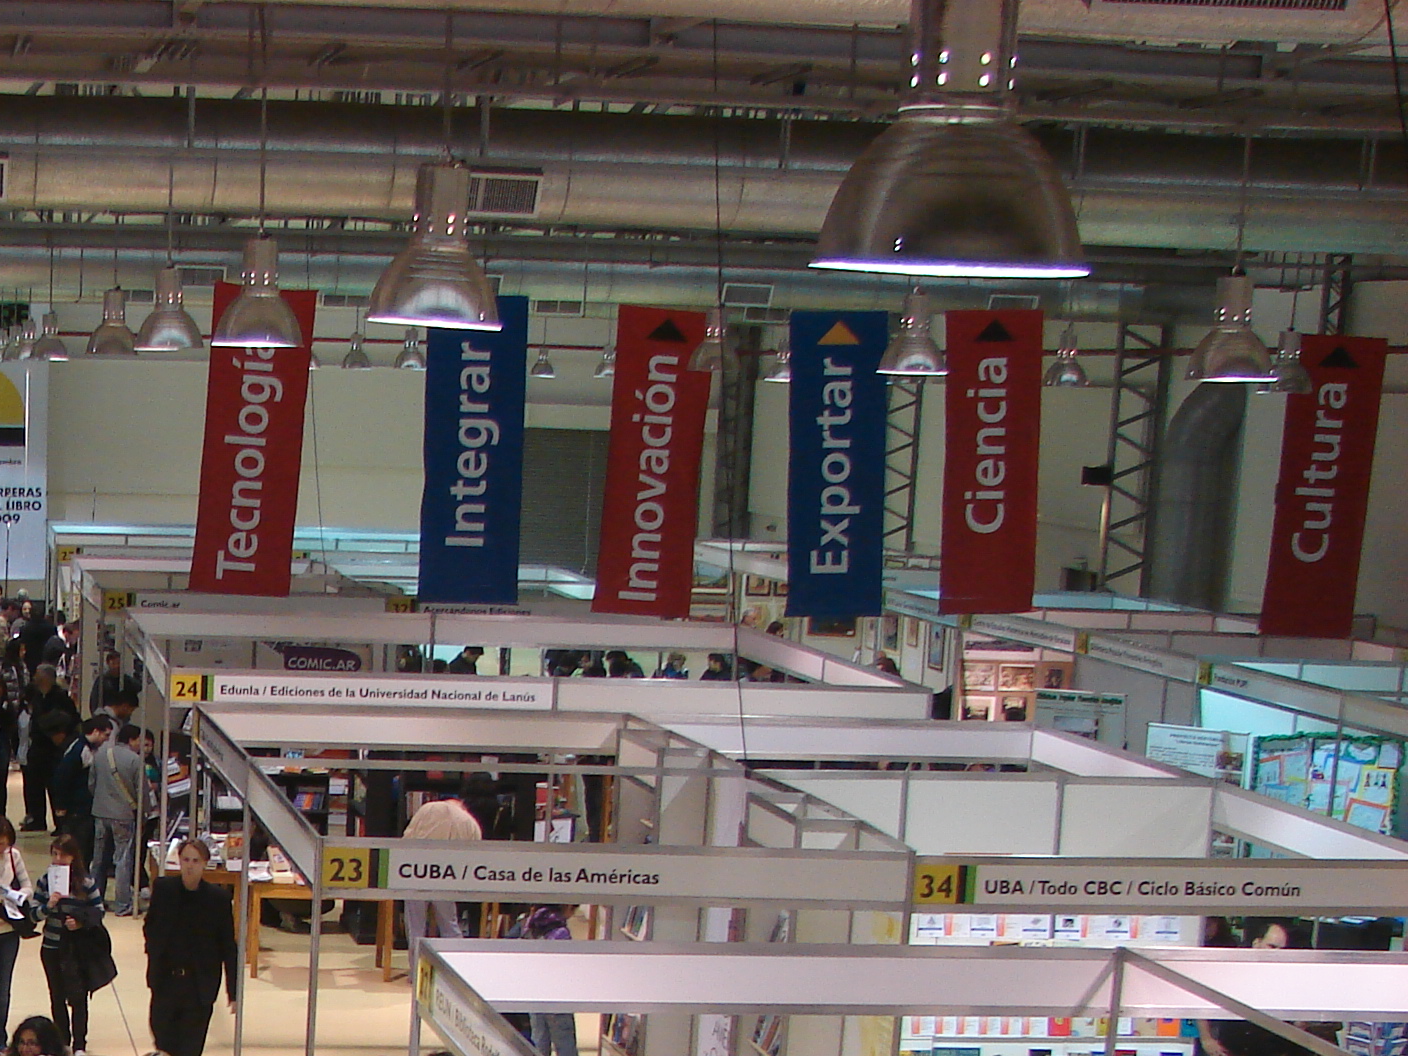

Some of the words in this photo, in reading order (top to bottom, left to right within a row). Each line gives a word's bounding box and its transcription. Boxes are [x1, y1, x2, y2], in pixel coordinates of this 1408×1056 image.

[445, 342, 500, 548] Integrar
[964, 356, 1008, 534] Ciencia
[618, 353, 679, 602] Innovación
[809, 357, 862, 575] Exportar
[1291, 381, 1349, 564] Cultura
[6, 501, 42, 511] LIBRO
[287, 657, 355, 672] COMIC.AR
[176, 681, 198, 697] 24
[220, 685, 260, 697] Edunla
[270, 686, 325, 698] Ediciones
[328, 687, 342, 698] de
[345, 687, 356, 698] la
[359, 688, 428, 700] Universidad
[432, 690, 482, 702] Nacional
[485, 691, 498, 702] de
[502, 691, 536, 703] Lanús
[329, 857, 363, 883] 23
[398, 863, 457, 880] CUBA
[473, 866, 516, 883] Casa
[522, 867, 543, 883] de
[548, 867, 572, 883] las
[575, 867, 660, 885] Américas
[920, 873, 953, 899] 34
[984, 879, 1024, 895] UBA
[1038, 880, 1078, 896] Todo
[1083, 880, 1122, 896] CBC
[1137, 881, 1178, 897] Ciclo
[1184, 879, 1237, 897] Básico
[1242, 880, 1301, 898] Común
